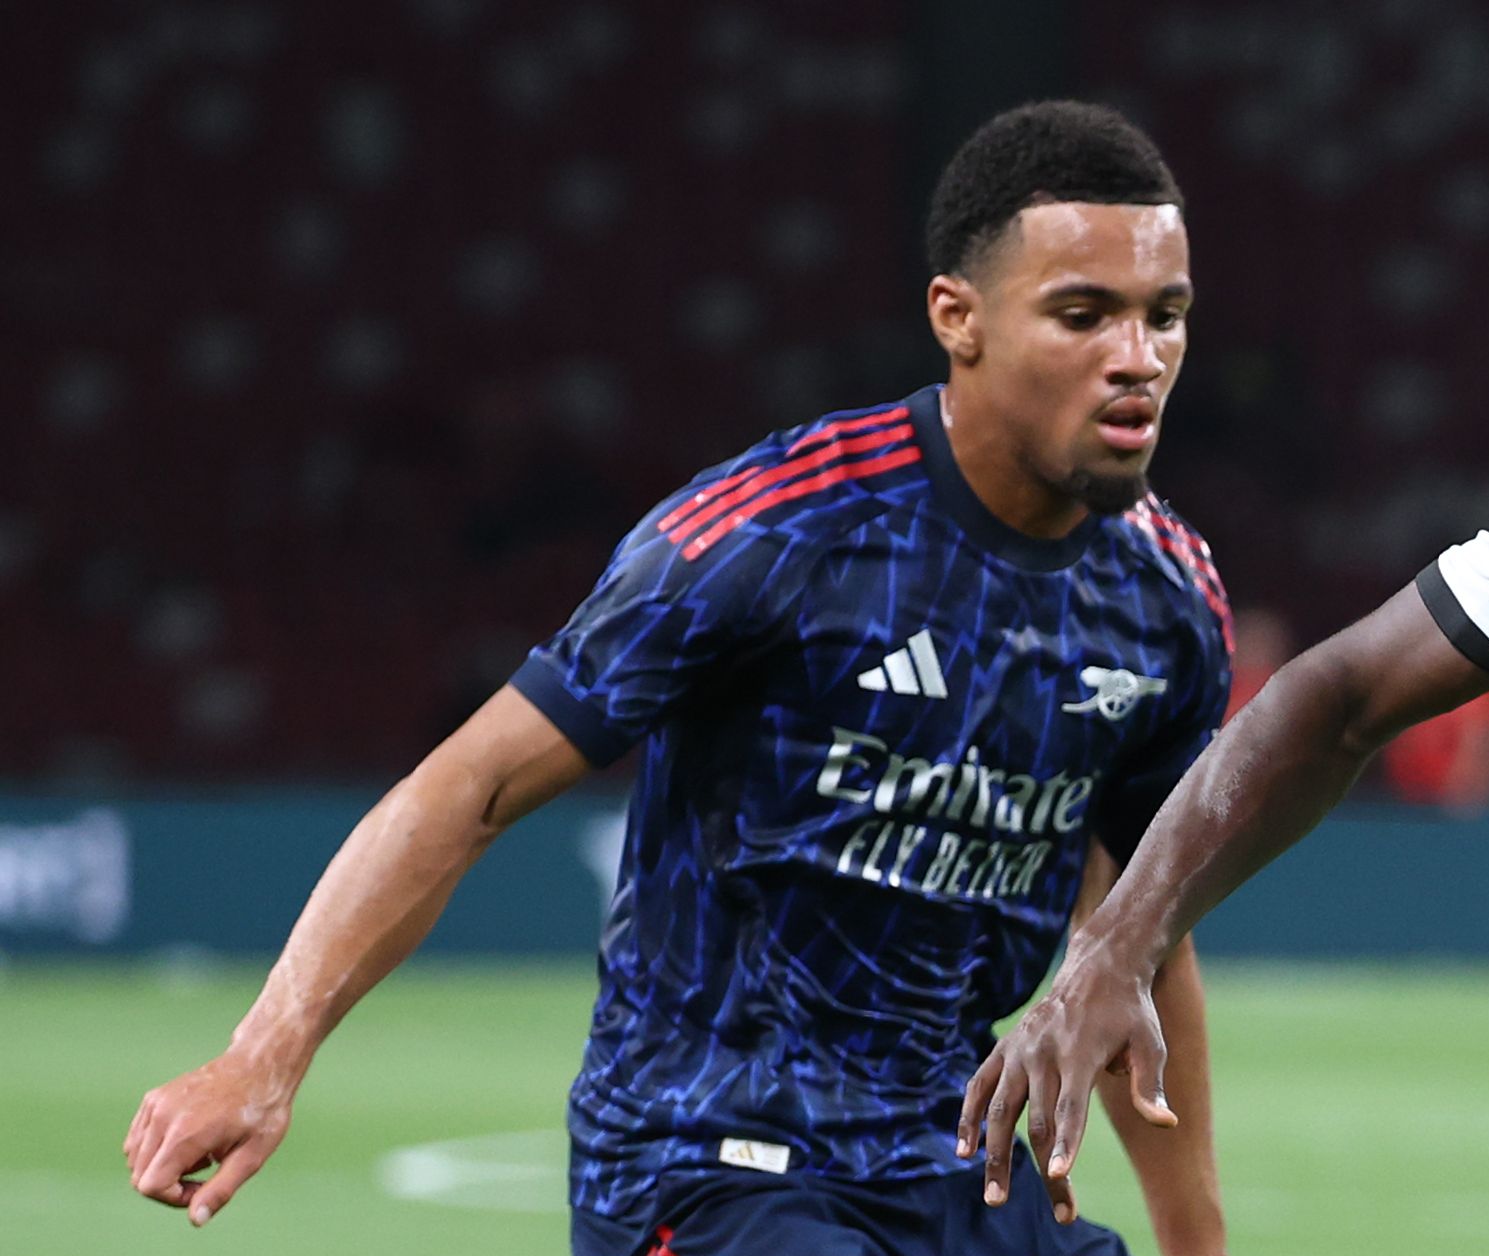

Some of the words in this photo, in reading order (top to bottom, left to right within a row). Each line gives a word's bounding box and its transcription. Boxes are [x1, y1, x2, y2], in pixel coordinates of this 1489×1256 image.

[816, 726, 1101, 834] Emirate
[836, 820, 926, 888] FLY
[920, 830, 1054, 898] BETTER
